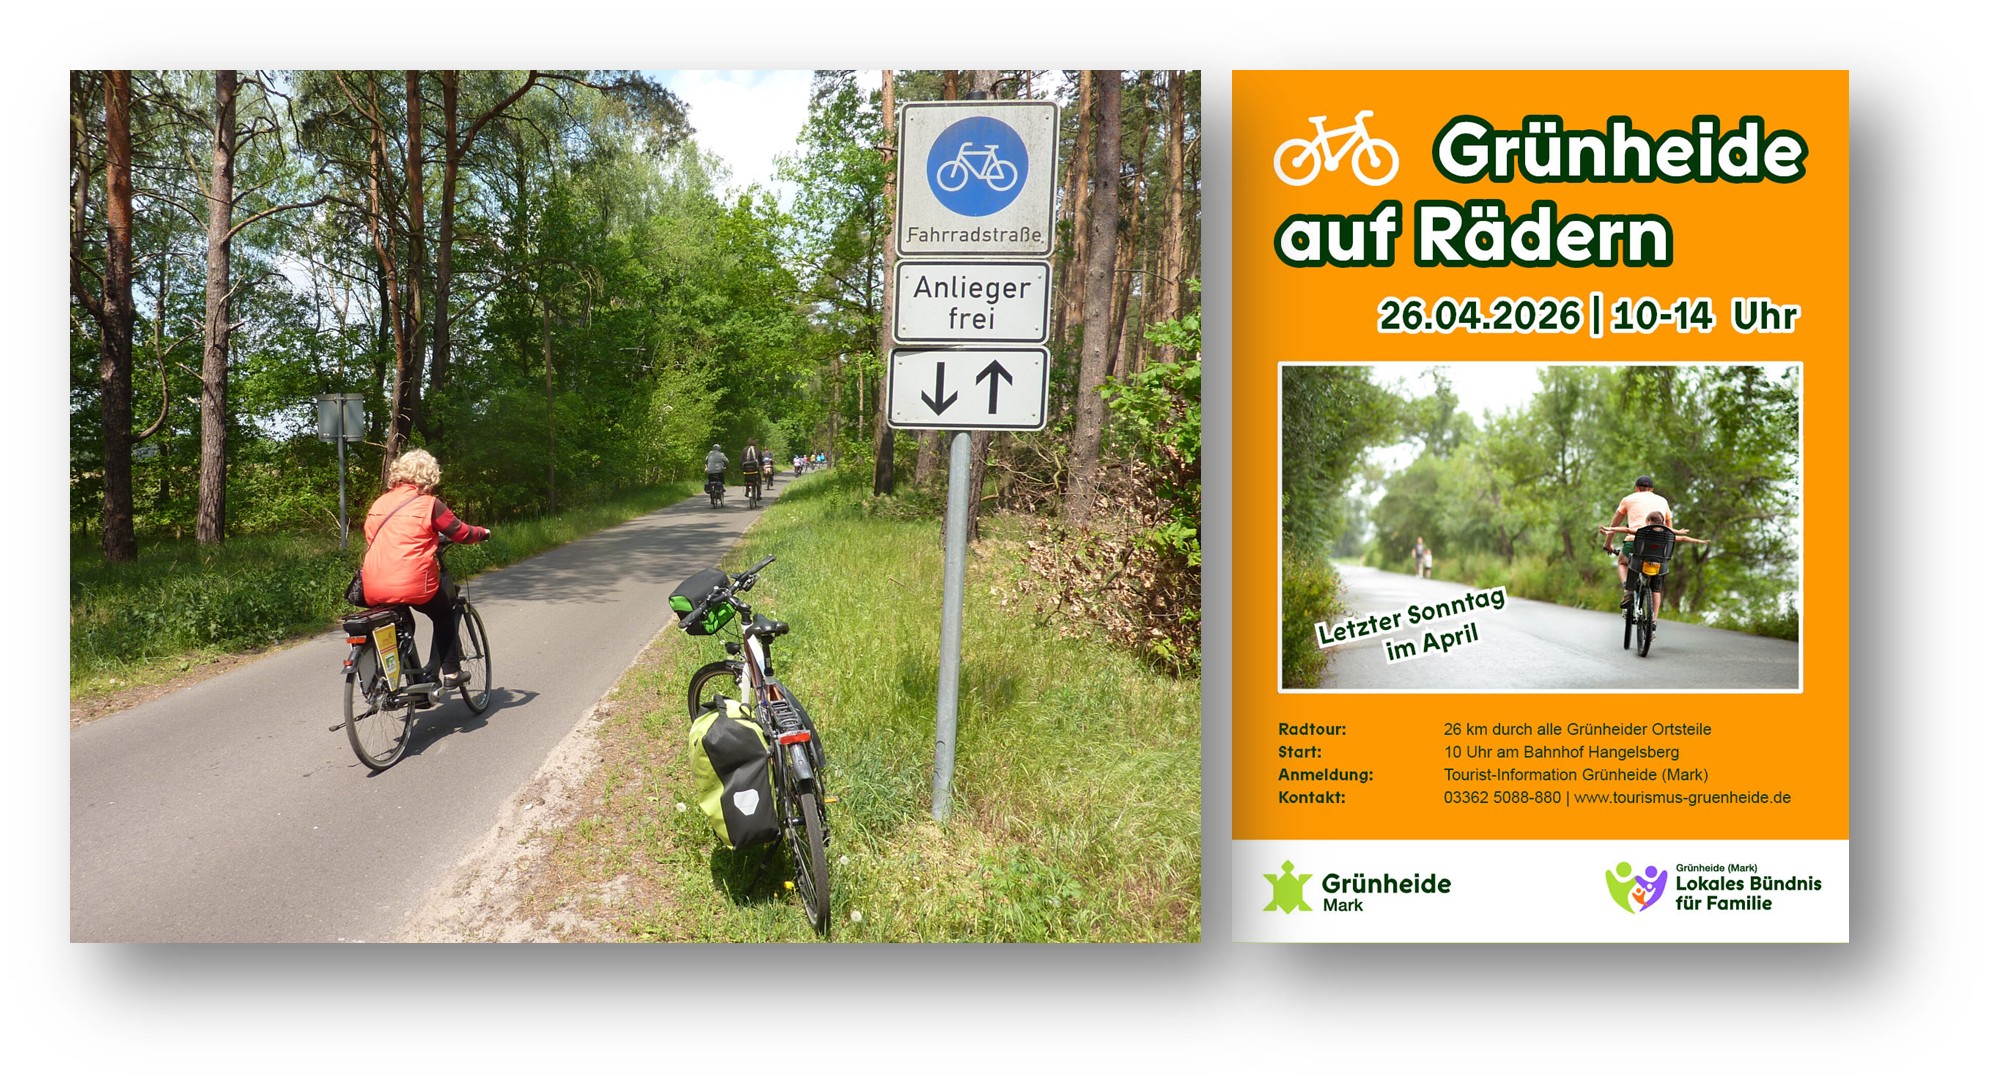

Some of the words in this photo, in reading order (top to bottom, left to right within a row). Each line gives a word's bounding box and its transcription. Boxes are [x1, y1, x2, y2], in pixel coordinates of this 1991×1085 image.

[1438, 121, 1802, 178] Grünheide
[908, 226, 1042, 243] Fahrradstraße
[1280, 206, 1396, 262] auf
[1420, 205, 1668, 262] Rädern
[913, 275, 1032, 305] Anlieger
[949, 307, 994, 330] frei
[1381, 300, 1580, 330] 26.04.2026
[1614, 300, 1713, 331] 10-14
[1734, 301, 1798, 330] Uhr
[1318, 612, 1402, 645] Letzter
[1407, 589, 1506, 625] Sonntag
[1385, 641, 1417, 661] im
[1423, 622, 1479, 653] April
[1279, 722, 1346, 736] Radtour:
[1444, 722, 1462, 736] 26
[1466, 722, 1488, 736] km
[1492, 722, 1533, 736] durch
[1537, 722, 1563, 736] alle
[1567, 722, 1648, 736] Grünheider
[1651, 722, 1712, 736] Ortsteile
[1278, 745, 1322, 759] Start:
[1445, 745, 1462, 759] 10
[1466, 745, 1493, 759] Uhr
[1497, 747, 1519, 759] am
[1524, 745, 1585, 759] Bahnhof
[1588, 745, 1680, 762] Hangelsberg
[1278, 767, 1373, 784] Anmeldung:
[1443, 767, 1577, 782] Tourist-Information
[1582, 767, 1658, 782] Grünheide
[1661, 767, 1709, 784] (Mark)
[1279, 790, 1345, 804] Kontakt:
[1443, 790, 1489, 804] 03362
[1493, 790, 1562, 804] 5088-880
[1574, 790, 1792, 807] www.tourismus-gruenheide.de
[1676, 863, 1726, 873] Grünheide
[1727, 863, 1758, 874] (Mark)
[1321, 872, 1452, 895] Grünheide
[1676, 875, 1745, 891] Lokales
[1750, 875, 1823, 891] Bündnis
[1323, 899, 1364, 912] Mark
[1675, 895, 1702, 911] für
[1707, 895, 1773, 911] Familie
